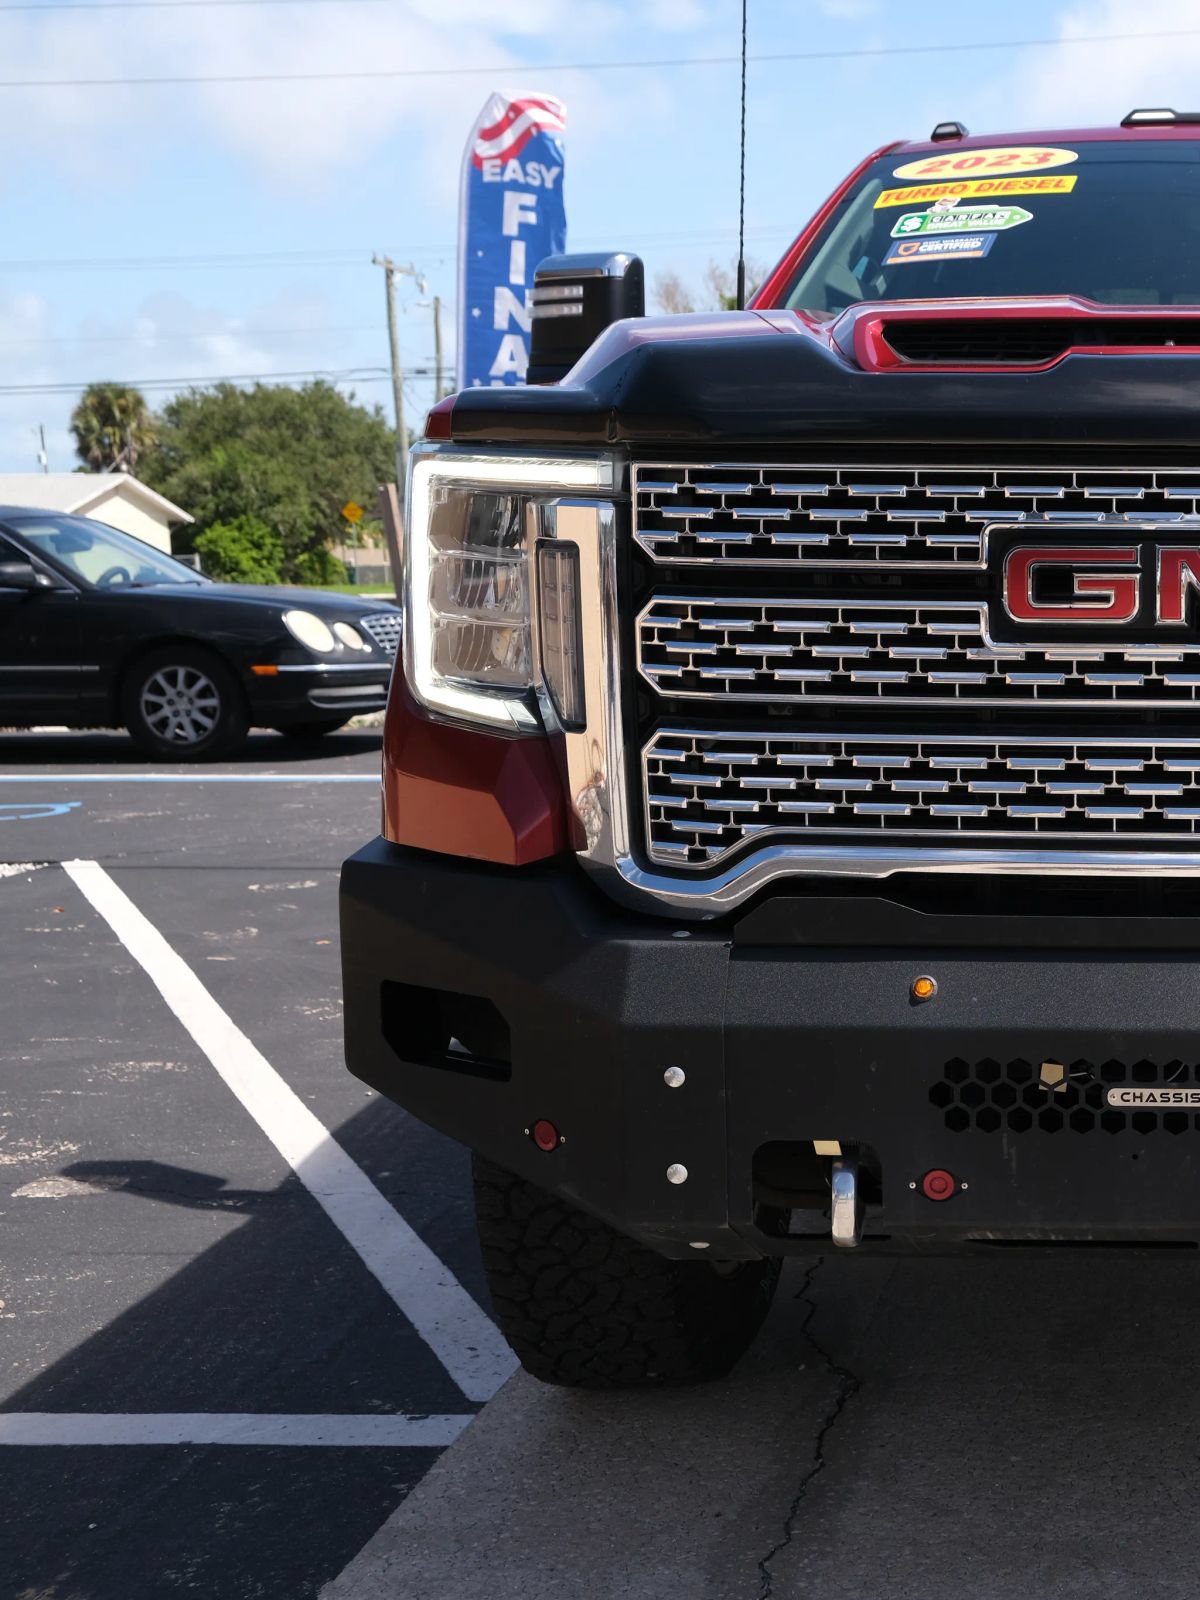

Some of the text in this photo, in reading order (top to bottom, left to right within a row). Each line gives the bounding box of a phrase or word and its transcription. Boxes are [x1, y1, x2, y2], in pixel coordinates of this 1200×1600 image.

[481, 158, 562, 190] EASY
[916, 152, 1055, 175] 2023
[880, 178, 1067, 204] TURBO DIESEL
[918, 241, 982, 252] CERTIFIED
[488, 190, 538, 387] FINA
